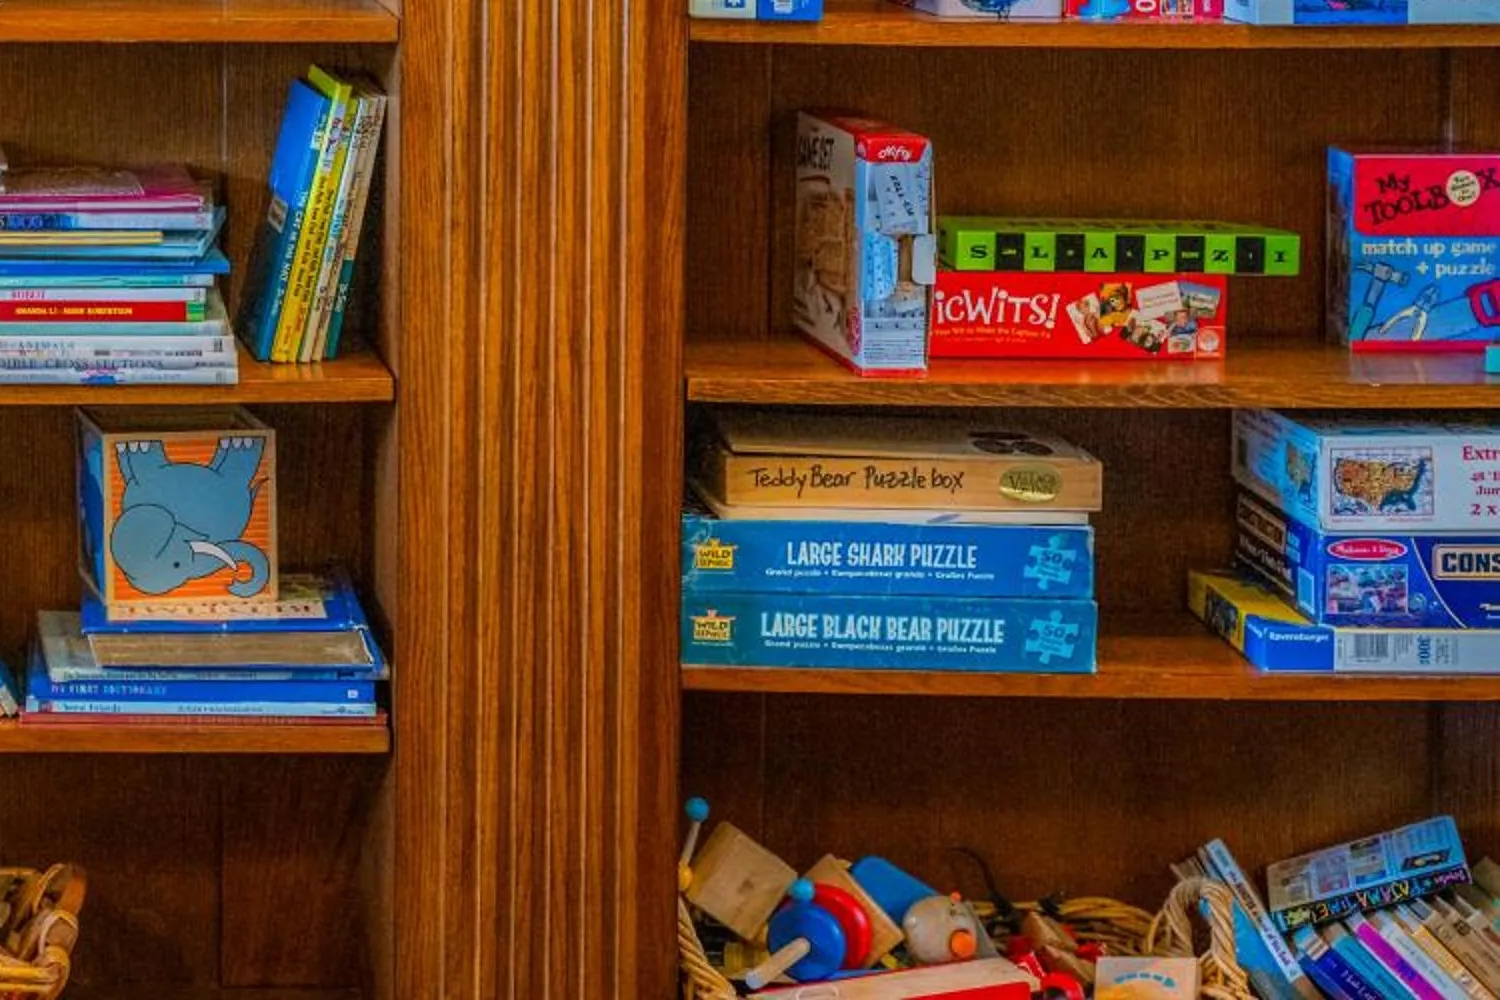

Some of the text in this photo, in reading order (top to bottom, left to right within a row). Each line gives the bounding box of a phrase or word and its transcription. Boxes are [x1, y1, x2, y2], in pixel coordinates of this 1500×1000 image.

[1376, 171, 1411, 194] My
[1364, 168, 1500, 225] TOOLBX
[1362, 239, 1497, 259] match up game
[1416, 259, 1495, 278] + puzzle
[748, 465, 965, 498] Teddy Bear Puzzle box
[1472, 504, 1481, 516] 2
[700, 551, 730, 559] WILD
[787, 541, 978, 569] LARGE SHARK PUZZLE
[760, 611, 1005, 643] LARGE BLACK BEAR PUZZLE
[1269, 631, 1329, 643] Ravensburger
